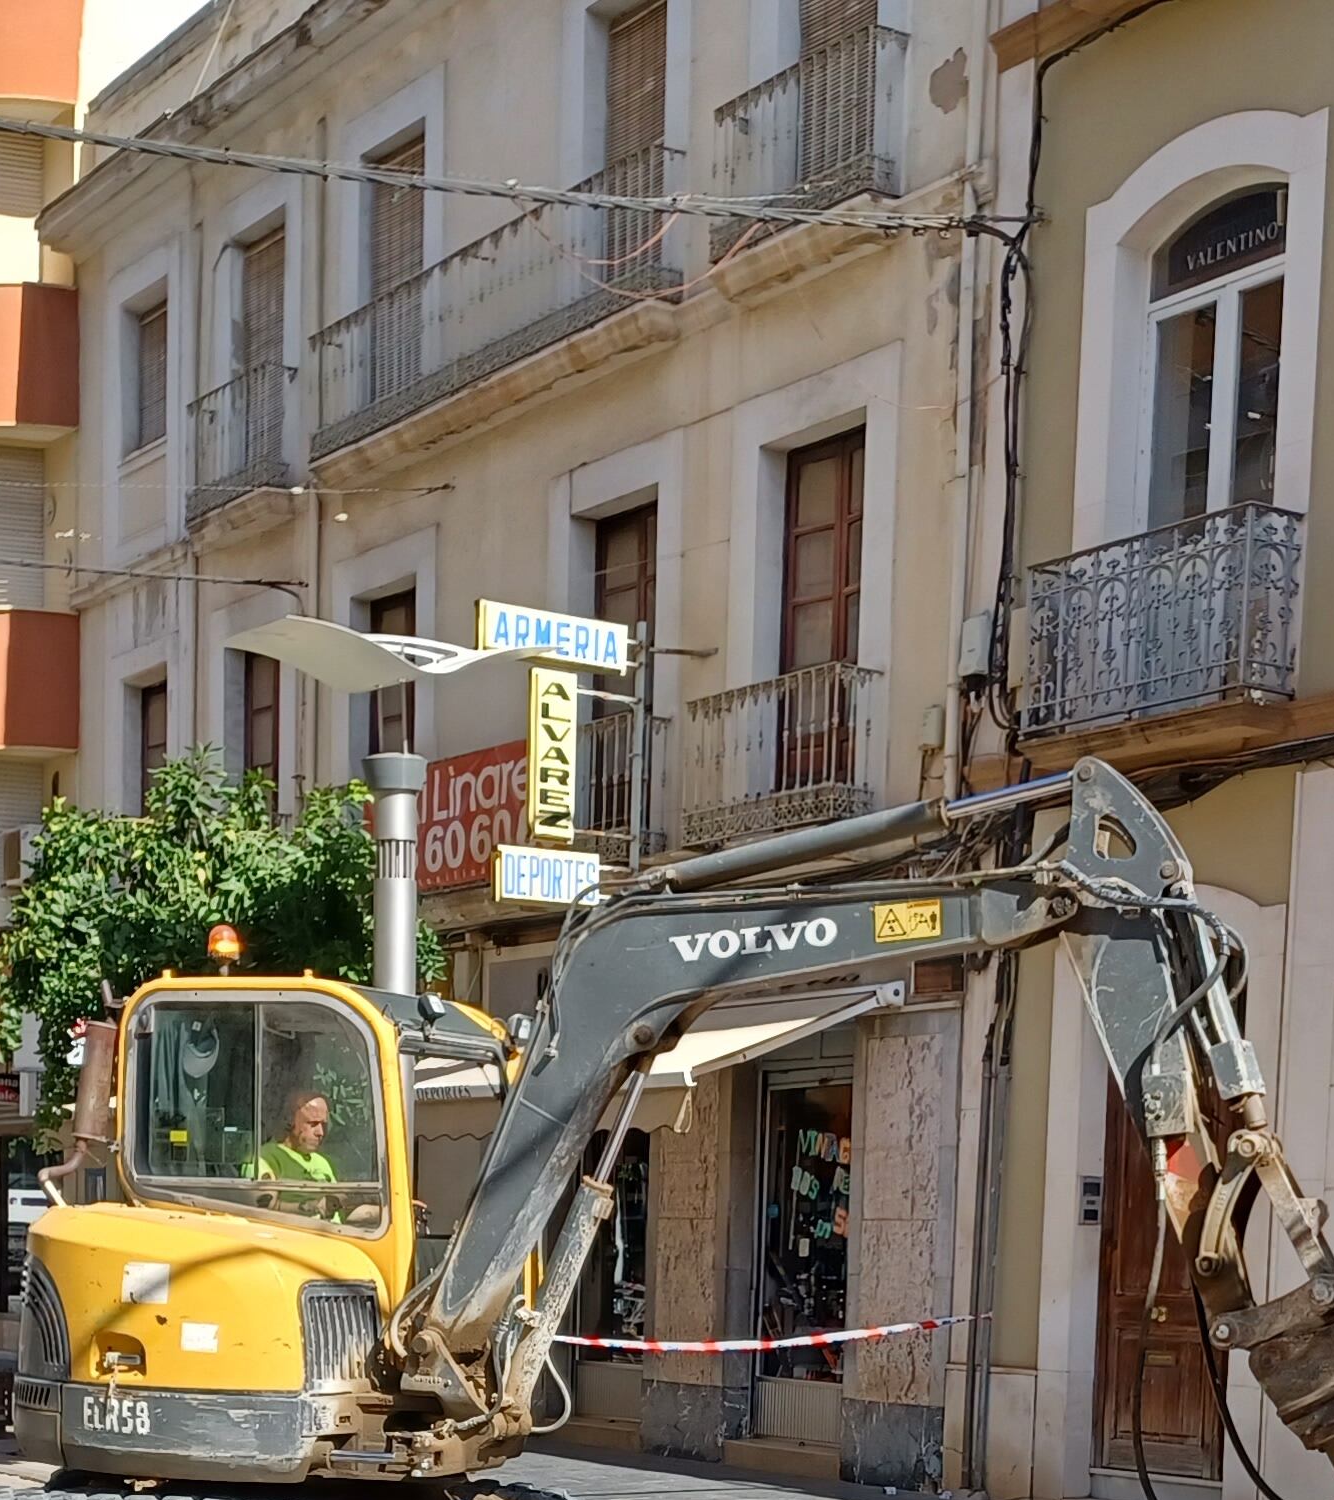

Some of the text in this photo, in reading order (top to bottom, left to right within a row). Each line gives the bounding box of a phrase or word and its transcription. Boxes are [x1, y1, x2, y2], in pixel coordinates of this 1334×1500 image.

[1187, 221, 1279, 271] VALENTINO
[494, 611, 618, 664] ARMERIA
[539, 681, 571, 829] ALVAREZ
[504, 853, 597, 901] DEPORTES
[669, 917, 838, 962] VOLVO
